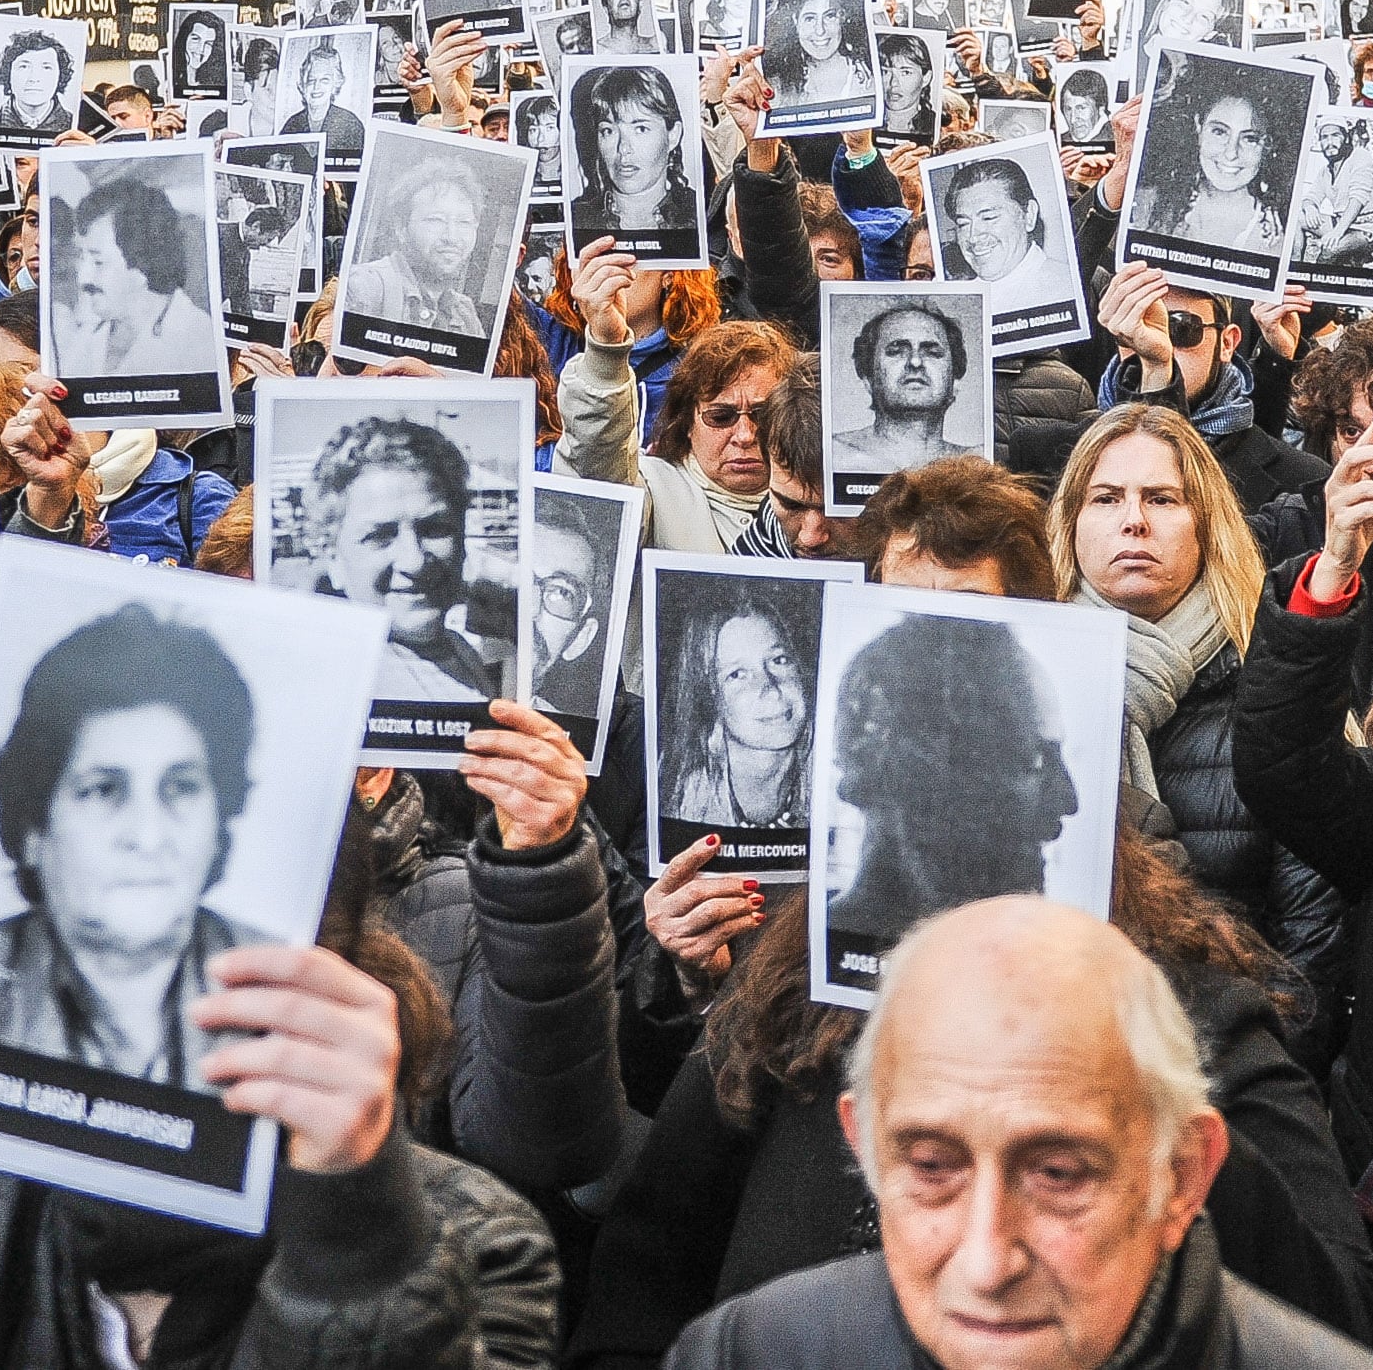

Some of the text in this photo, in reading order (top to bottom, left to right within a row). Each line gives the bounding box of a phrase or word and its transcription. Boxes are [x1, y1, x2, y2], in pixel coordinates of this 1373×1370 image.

[1130, 242, 1270, 279] CYNTHIA VERONICA GOLDENBERG
[364, 329, 392, 344] ANGEL
[738, 843, 806, 858] MERCOVICH
[840, 952, 879, 974] JOSE
